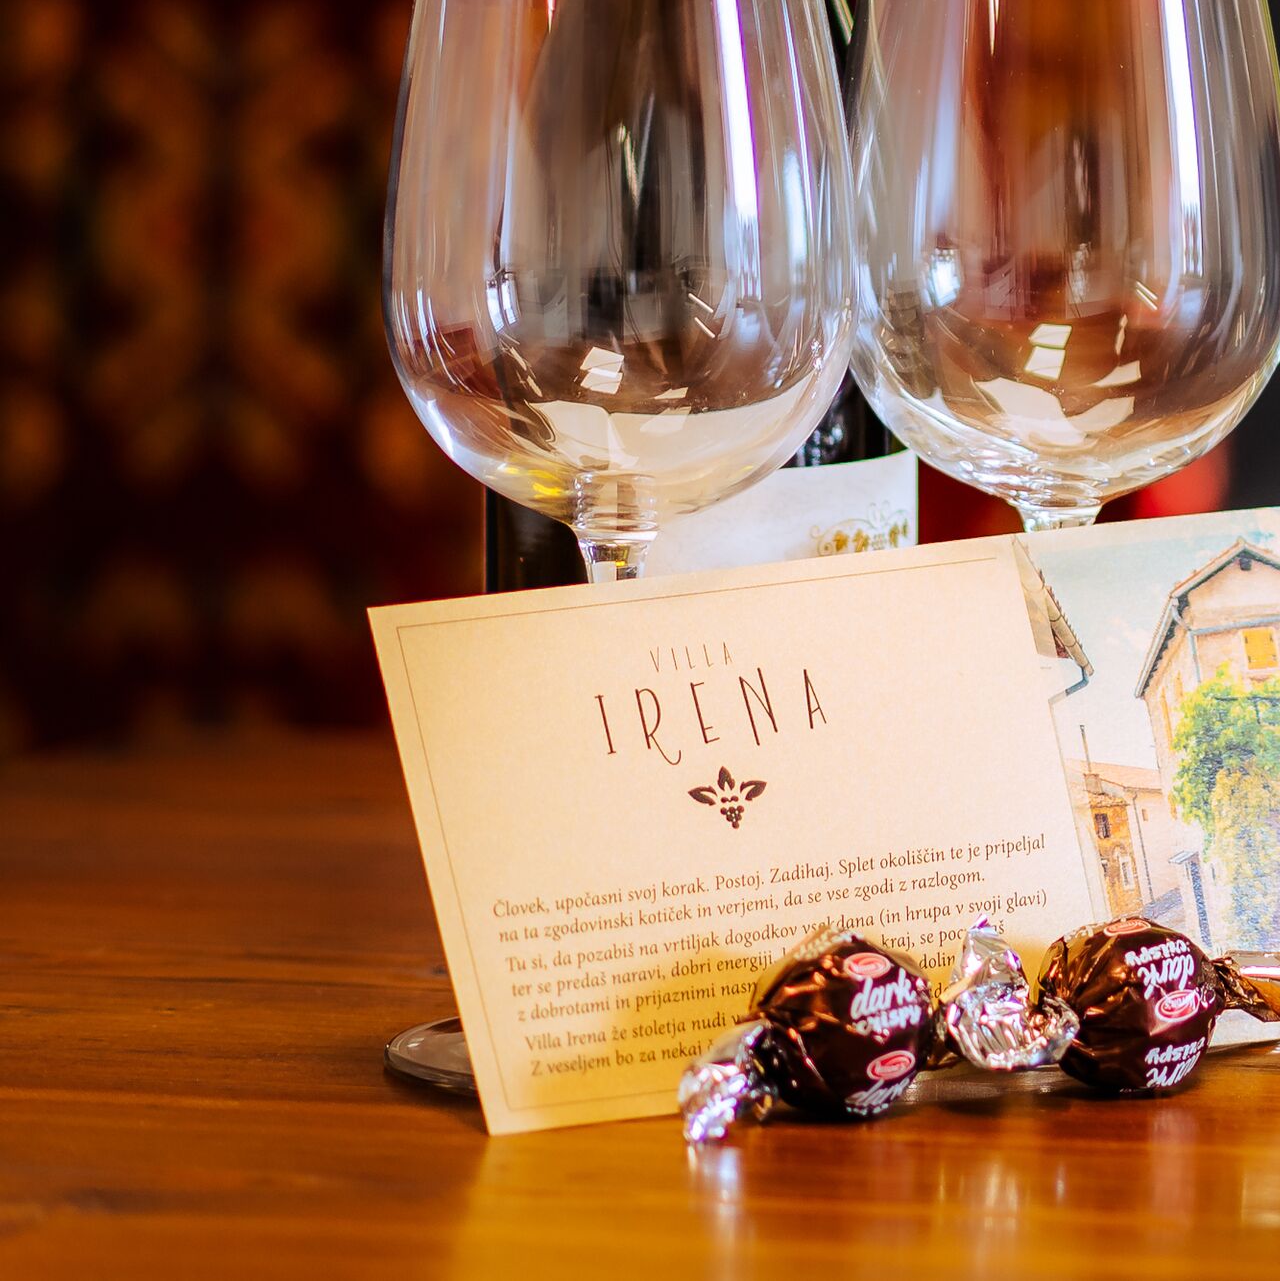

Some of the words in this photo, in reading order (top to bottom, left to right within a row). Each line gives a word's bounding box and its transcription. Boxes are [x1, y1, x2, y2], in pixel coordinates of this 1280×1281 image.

[649, 641, 733, 673] VILLA
[594, 667, 827, 766] IRENA
[492, 896, 551, 918] Človek,
[554, 887, 623, 913] upočasni
[627, 883, 657, 902] svoj
[661, 877, 710, 898] korak.
[715, 870, 765, 891] Postoj.
[769, 861, 834, 884] Zadihaj.
[838, 856, 876, 878] Splet
[879, 847, 945, 870] okoliščin
[950, 846, 964, 861] te
[967, 842, 981, 863] je
[985, 833, 1045, 861] pripeljal
[498, 929, 519, 943] na
[523, 925, 540, 941] ta
[543, 911, 634, 941] zgodovinski
[638, 903, 693, 926] kotiček
[696, 903, 713, 919] in
[716, 893, 779, 918] verjemi,
[783, 889, 803, 908] da
[807, 891, 822, 904] se
[826, 887, 850, 902] vse
[853, 877, 895, 902] zgodi
[898, 879, 908, 893] z
[910, 870, 985, 891] razlogom.
[504, 956, 527, 973] Tu
[531, 953, 548, 971] si,
[552, 949, 573, 968] da
[576, 941, 635, 968] pozabiš
[638, 943, 659, 957] na
[663, 930, 721, 953] vrtiljak
[724, 923, 798, 947] dogodkov
[879, 908, 901, 928] (in
[905, 905, 951, 924] hrupa
[955, 903, 964, 915] v
[968, 895, 1002, 915] svoji
[1006, 888, 1048, 913] glavi)
[511, 983, 533, 998] ter
[536, 981, 552, 995] se
[556, 970, 608, 996] predaš
[611, 964, 666, 986] naravi,
[670, 957, 712, 978] dobri
[881, 931, 916, 950] kraj,
[919, 932, 935, 945] se
[1137, 954, 1194, 1000] dark
[517, 1010, 527, 1023] z
[530, 995, 611, 1021] dobrotami
[615, 994, 631, 1010] in
[635, 982, 716, 1010] prijaznimi
[850, 966, 915, 1019] dark
[523, 1032, 563, 1052] Villa
[566, 1030, 608, 1047] Irena
[611, 1025, 628, 1042] že
[631, 1018, 687, 1039] stoletja
[691, 1010, 727, 1031] nudi
[530, 1059, 543, 1077] Z
[546, 1053, 612, 1075] veseljem
[614, 1048, 635, 1067] bo
[638, 1049, 657, 1063] za
[660, 1040, 703, 1061] nekaj
